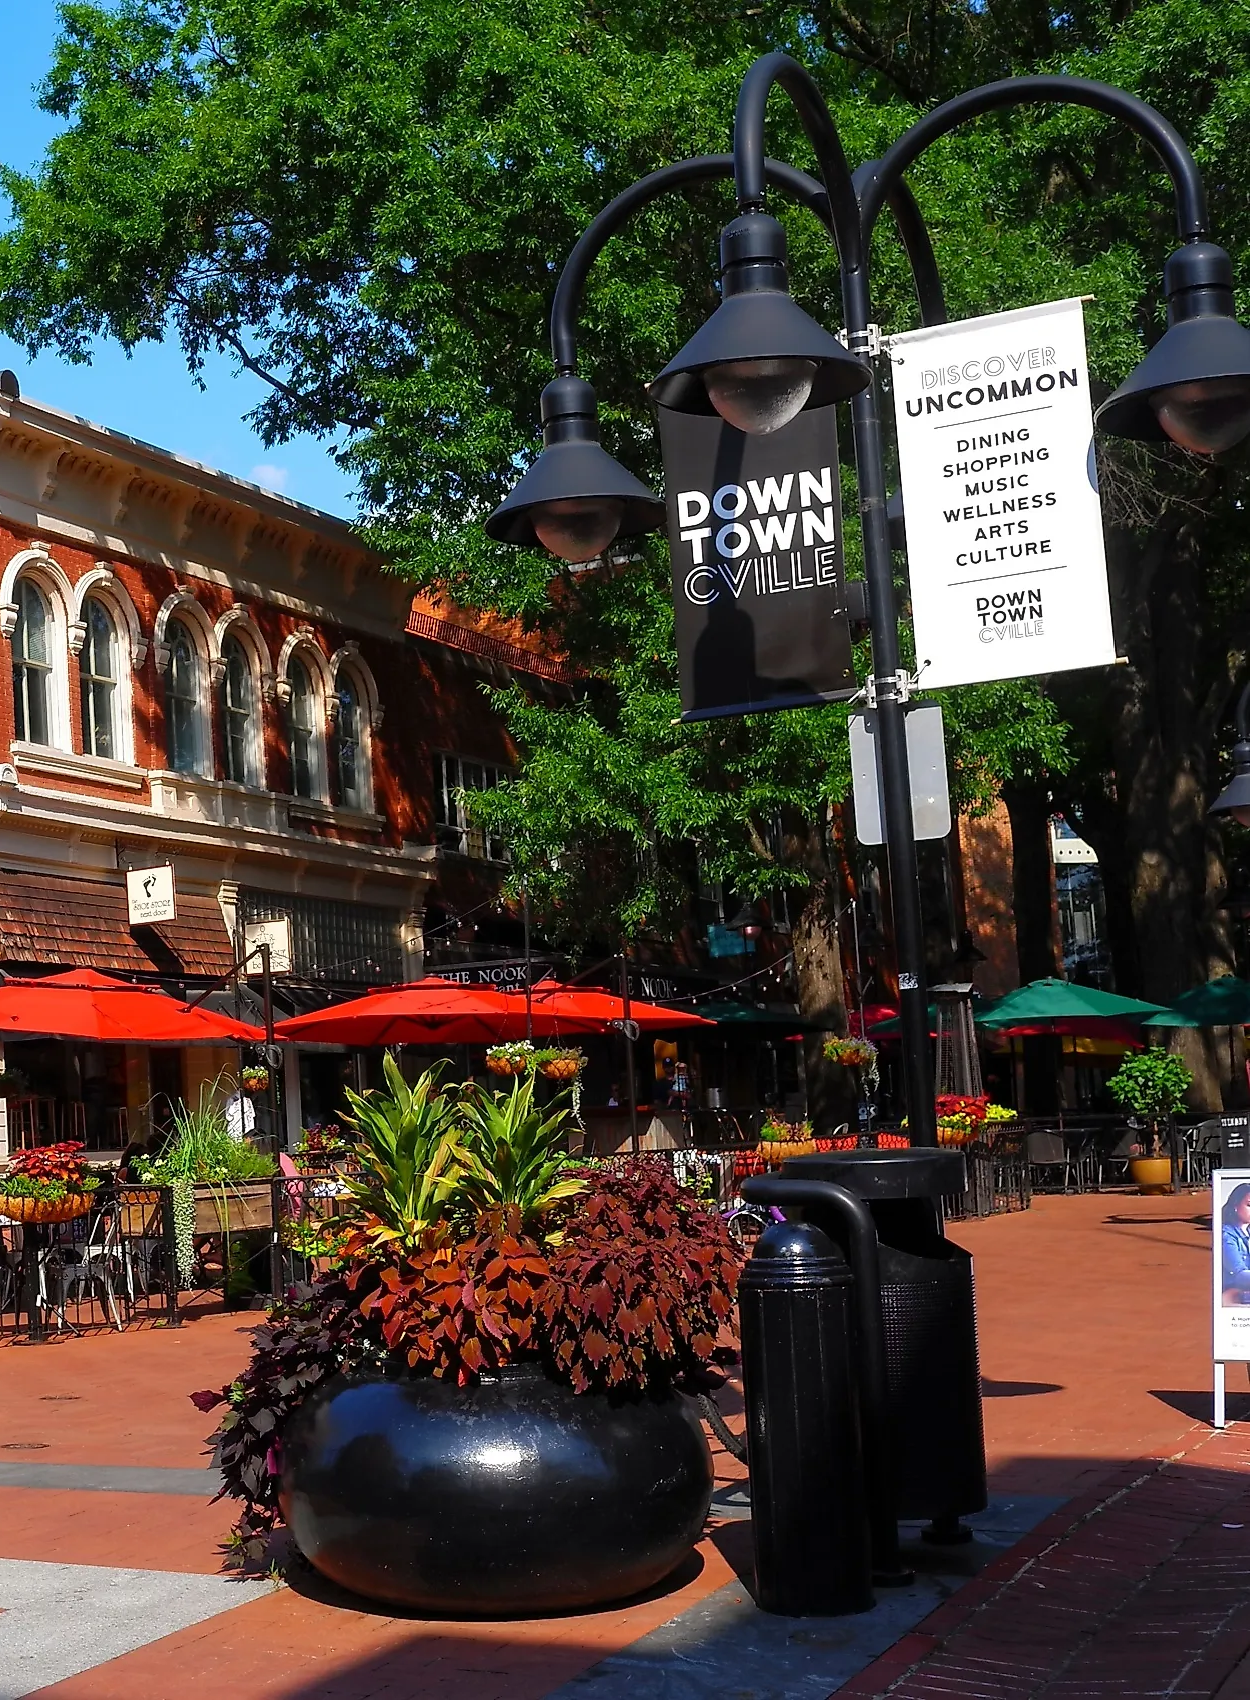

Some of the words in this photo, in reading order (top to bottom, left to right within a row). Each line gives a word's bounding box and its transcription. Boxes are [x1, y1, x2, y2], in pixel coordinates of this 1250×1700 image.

[920, 346, 1057, 390] DISCOVER
[905, 368, 1078, 417] UNCOMMON
[956, 428, 1030, 453] DINING
[942, 447, 1050, 478] SHOPPING
[676, 466, 833, 528] DOWN
[964, 474, 1029, 497] MUSIC
[943, 492, 1057, 523] WELLNESS
[679, 505, 835, 565] TOWN
[974, 519, 1029, 541] ARTS
[956, 539, 1052, 567] CULTURE
[683, 544, 837, 606] CVILLE
[975, 588, 1042, 612] DOWN
[977, 604, 1043, 627] TOWN
[978, 619, 1045, 644] CVILLE
[438, 971, 471, 985] THE
[478, 965, 528, 984] NOOK
